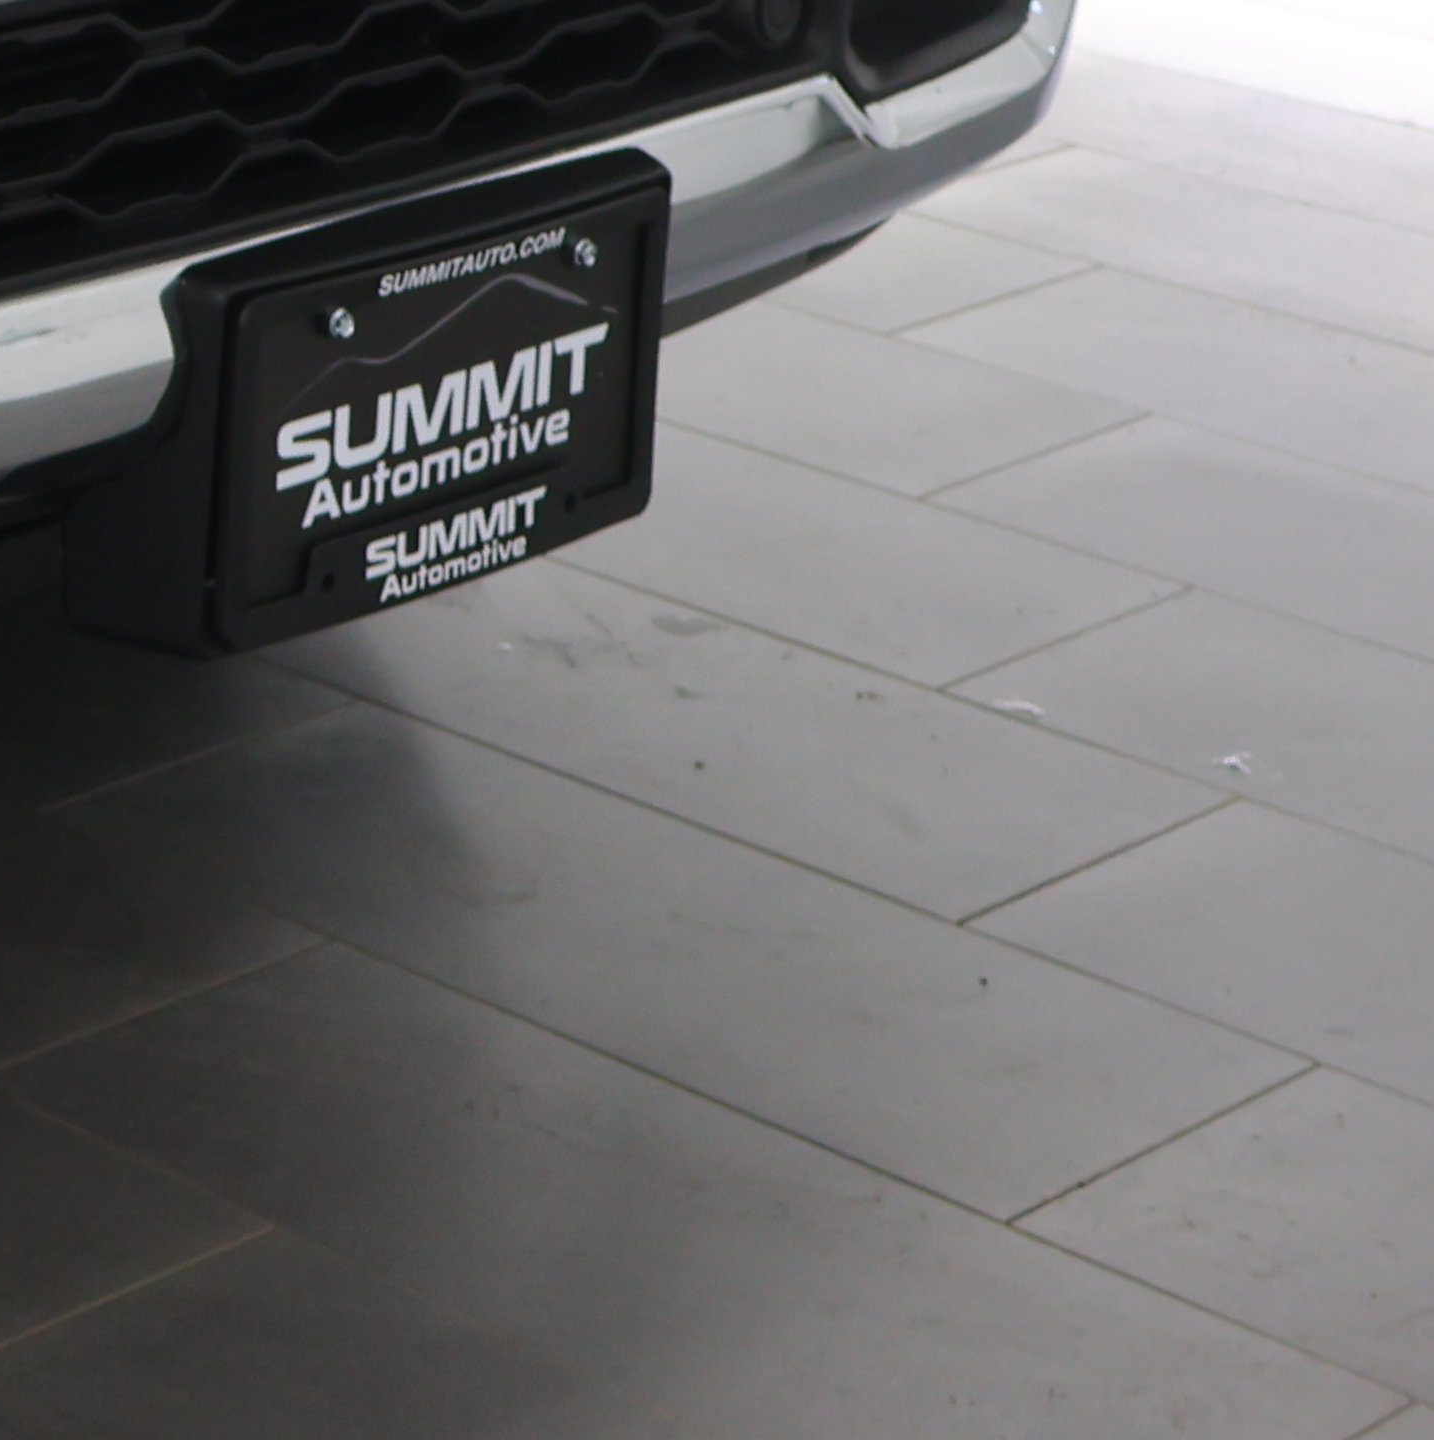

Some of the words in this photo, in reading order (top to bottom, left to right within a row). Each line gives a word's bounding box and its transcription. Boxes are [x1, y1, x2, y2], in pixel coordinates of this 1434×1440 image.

[378, 227, 566, 297] SUMMITAUTO.COM
[276, 322, 610, 491] SUMMIT
[301, 407, 571, 528] Automotive
[365, 486, 547, 579] SUMMIT
[380, 534, 527, 602] Automotive
